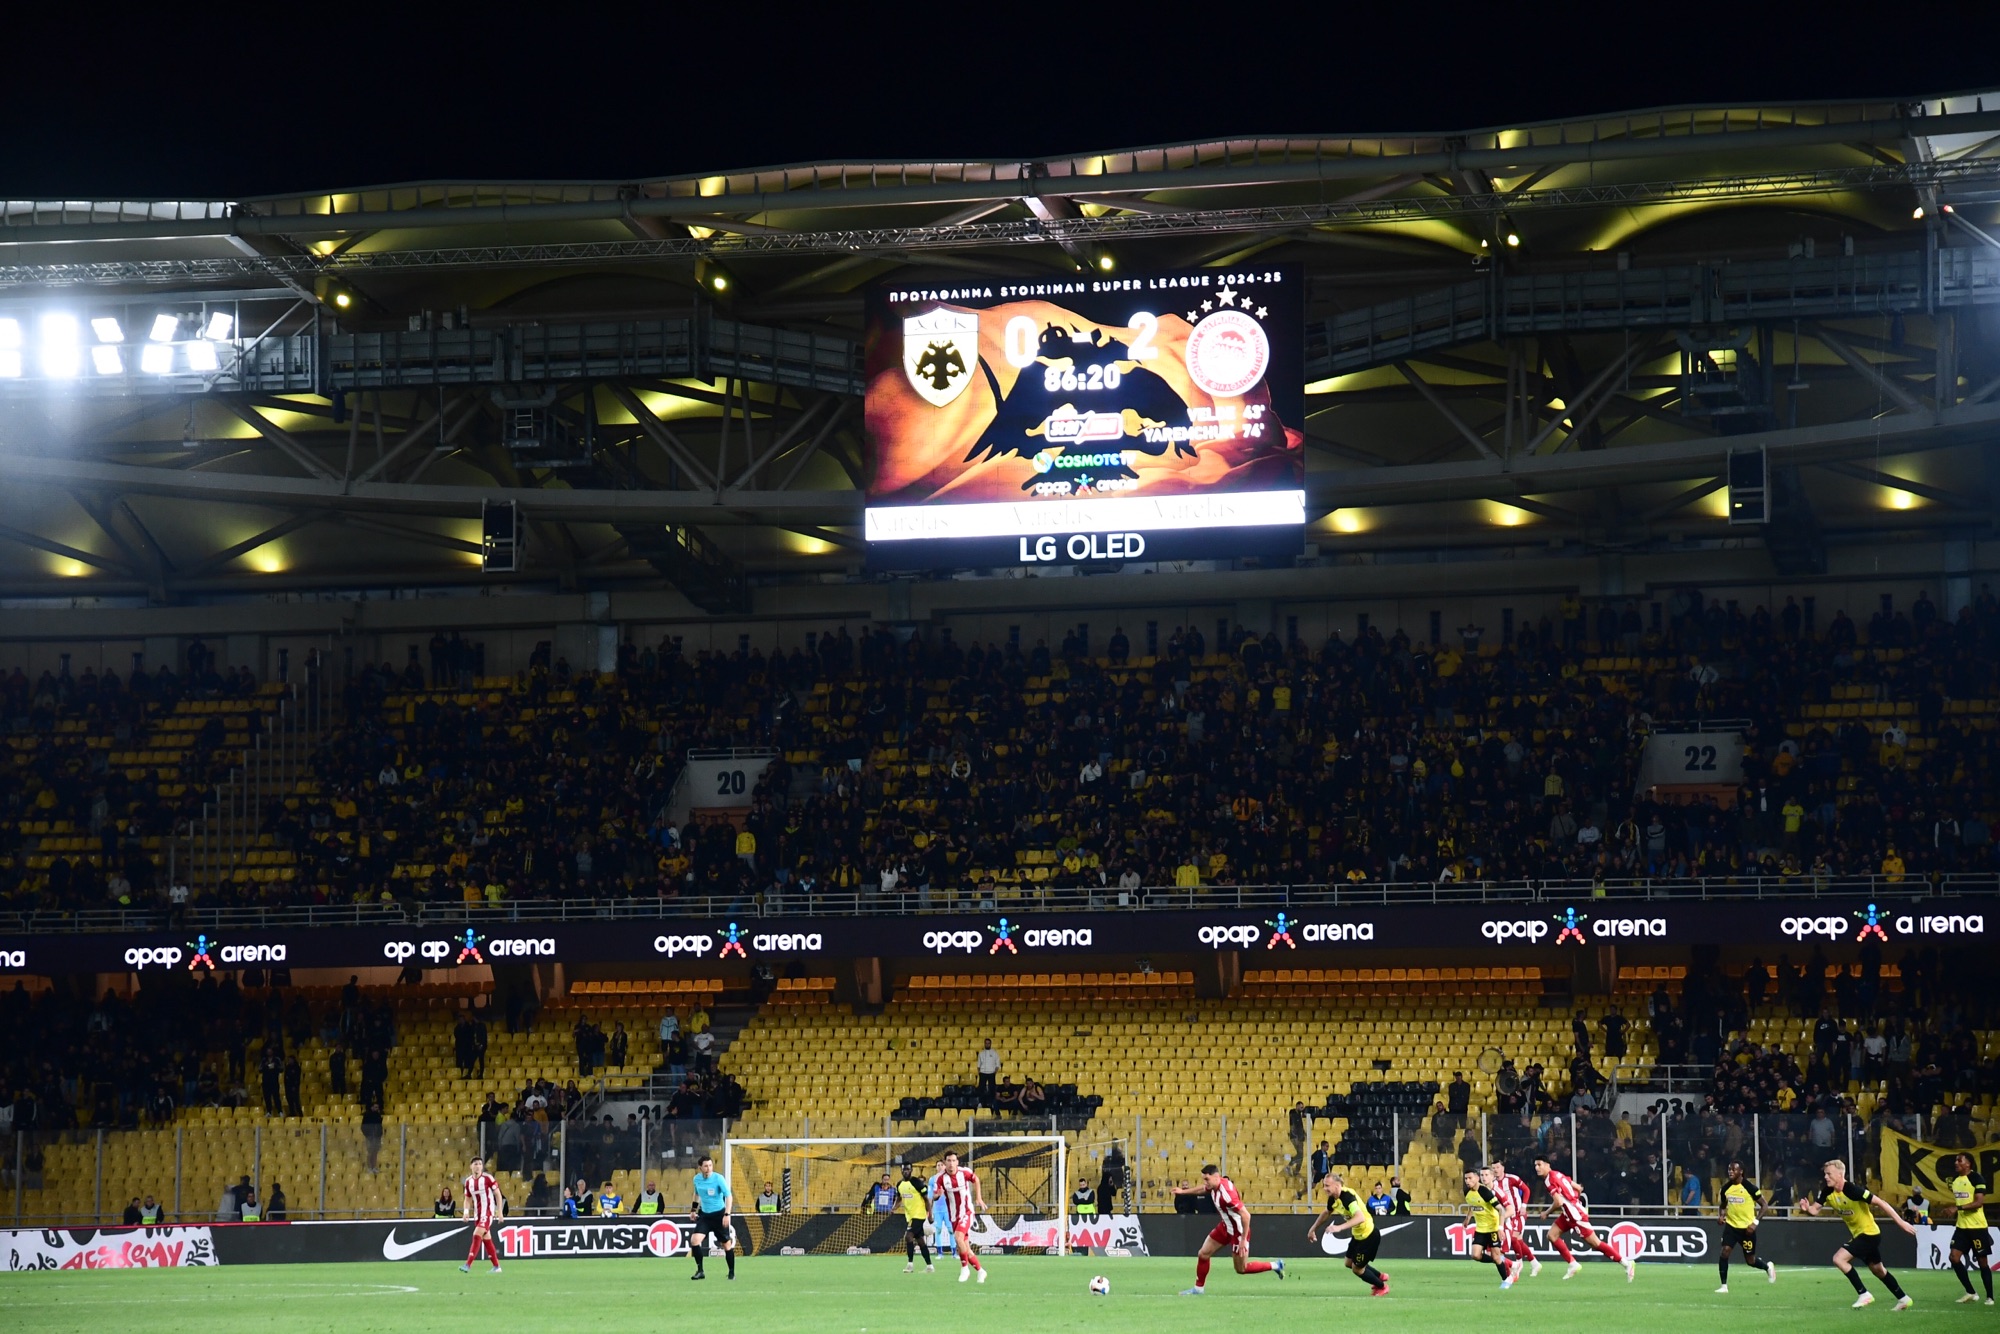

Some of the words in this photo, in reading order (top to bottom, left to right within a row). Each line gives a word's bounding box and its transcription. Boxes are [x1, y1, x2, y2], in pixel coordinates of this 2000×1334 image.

[889, 286, 993, 303] ΠΡΩΤΑΘΛΗΜΑ
[1000, 283, 1085, 297] STOIXIMAN
[1092, 279, 1142, 292] SUPER
[1149, 275, 1210, 289] LEAGUE
[1217, 271, 1282, 286] 2024-25
[1005, 316, 1038, 368] 0
[1127, 311, 1158, 360] 2
[1044, 364, 1121, 391] 86:20
[1035, 481, 1072, 497] opap
[1020, 536, 1057, 561] LG
[1066, 532, 1146, 560] OLED
[1684, 745, 1717, 771] 22
[717, 770, 746, 795] 20
[923, 930, 982, 954] opap
[1024, 925, 1092, 946] arena
[1198, 924, 1260, 949] opap
[1302, 921, 1374, 942] arena
[1592, 917, 1667, 937] arena
[1780, 915, 1848, 941] opap
[124, 944, 182, 969] opap
[220, 942, 286, 962] arena
[489, 937, 555, 957] arena
[654, 934, 713, 958] opap
[753, 932, 821, 951] arena
[1742, 1240, 1753, 1250] 29
